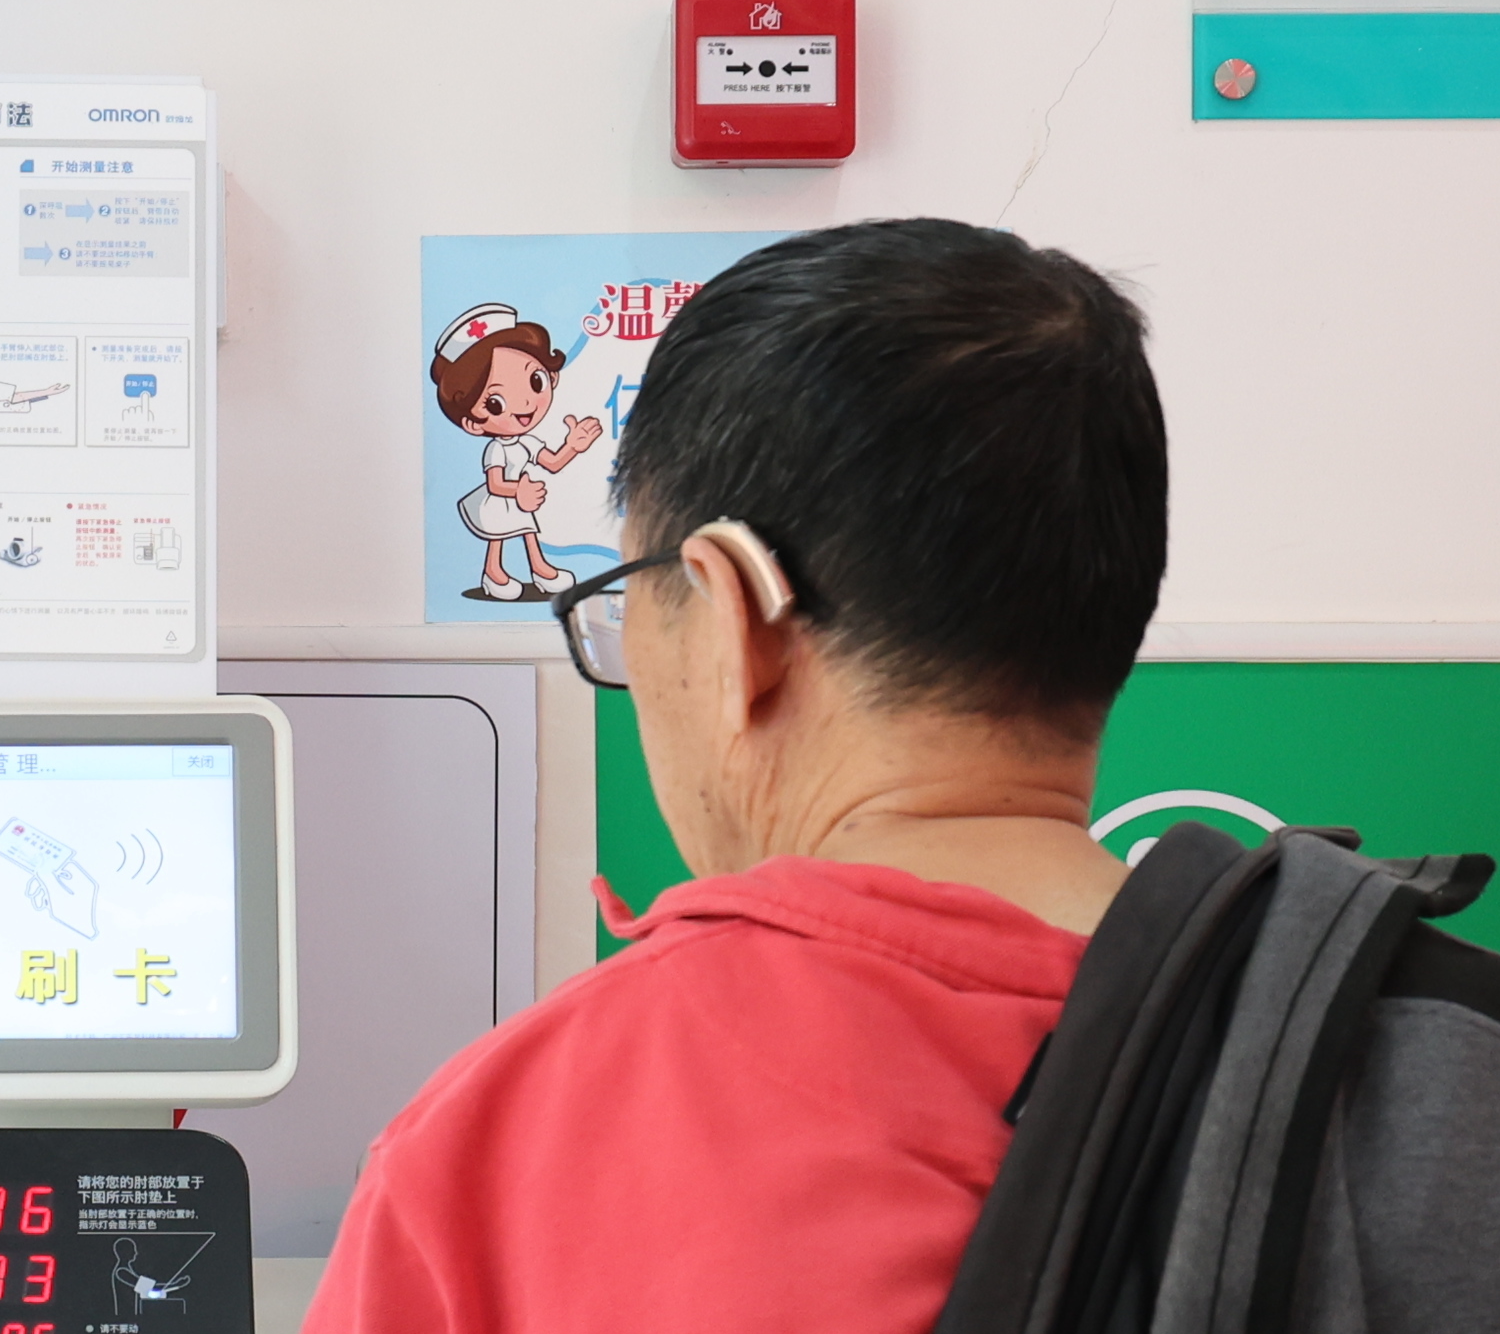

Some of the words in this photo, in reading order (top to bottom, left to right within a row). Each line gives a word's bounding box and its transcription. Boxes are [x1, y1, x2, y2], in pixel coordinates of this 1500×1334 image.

[723, 84, 748, 92] PRESS
[751, 84, 770, 92] HERE
[88, 108, 160, 122] OMRON
[51, 160, 134, 173] 开始测量注意
[186, 754, 215, 769] 关闭
[77, 1175, 204, 1189] 请将您的肘部放置于
[77, 1190, 177, 1204] 下图所示肘垫上
[79, 1220, 157, 1230] 指示灯会显示蓝色
[100, 1323, 139, 1334] 请不要动
